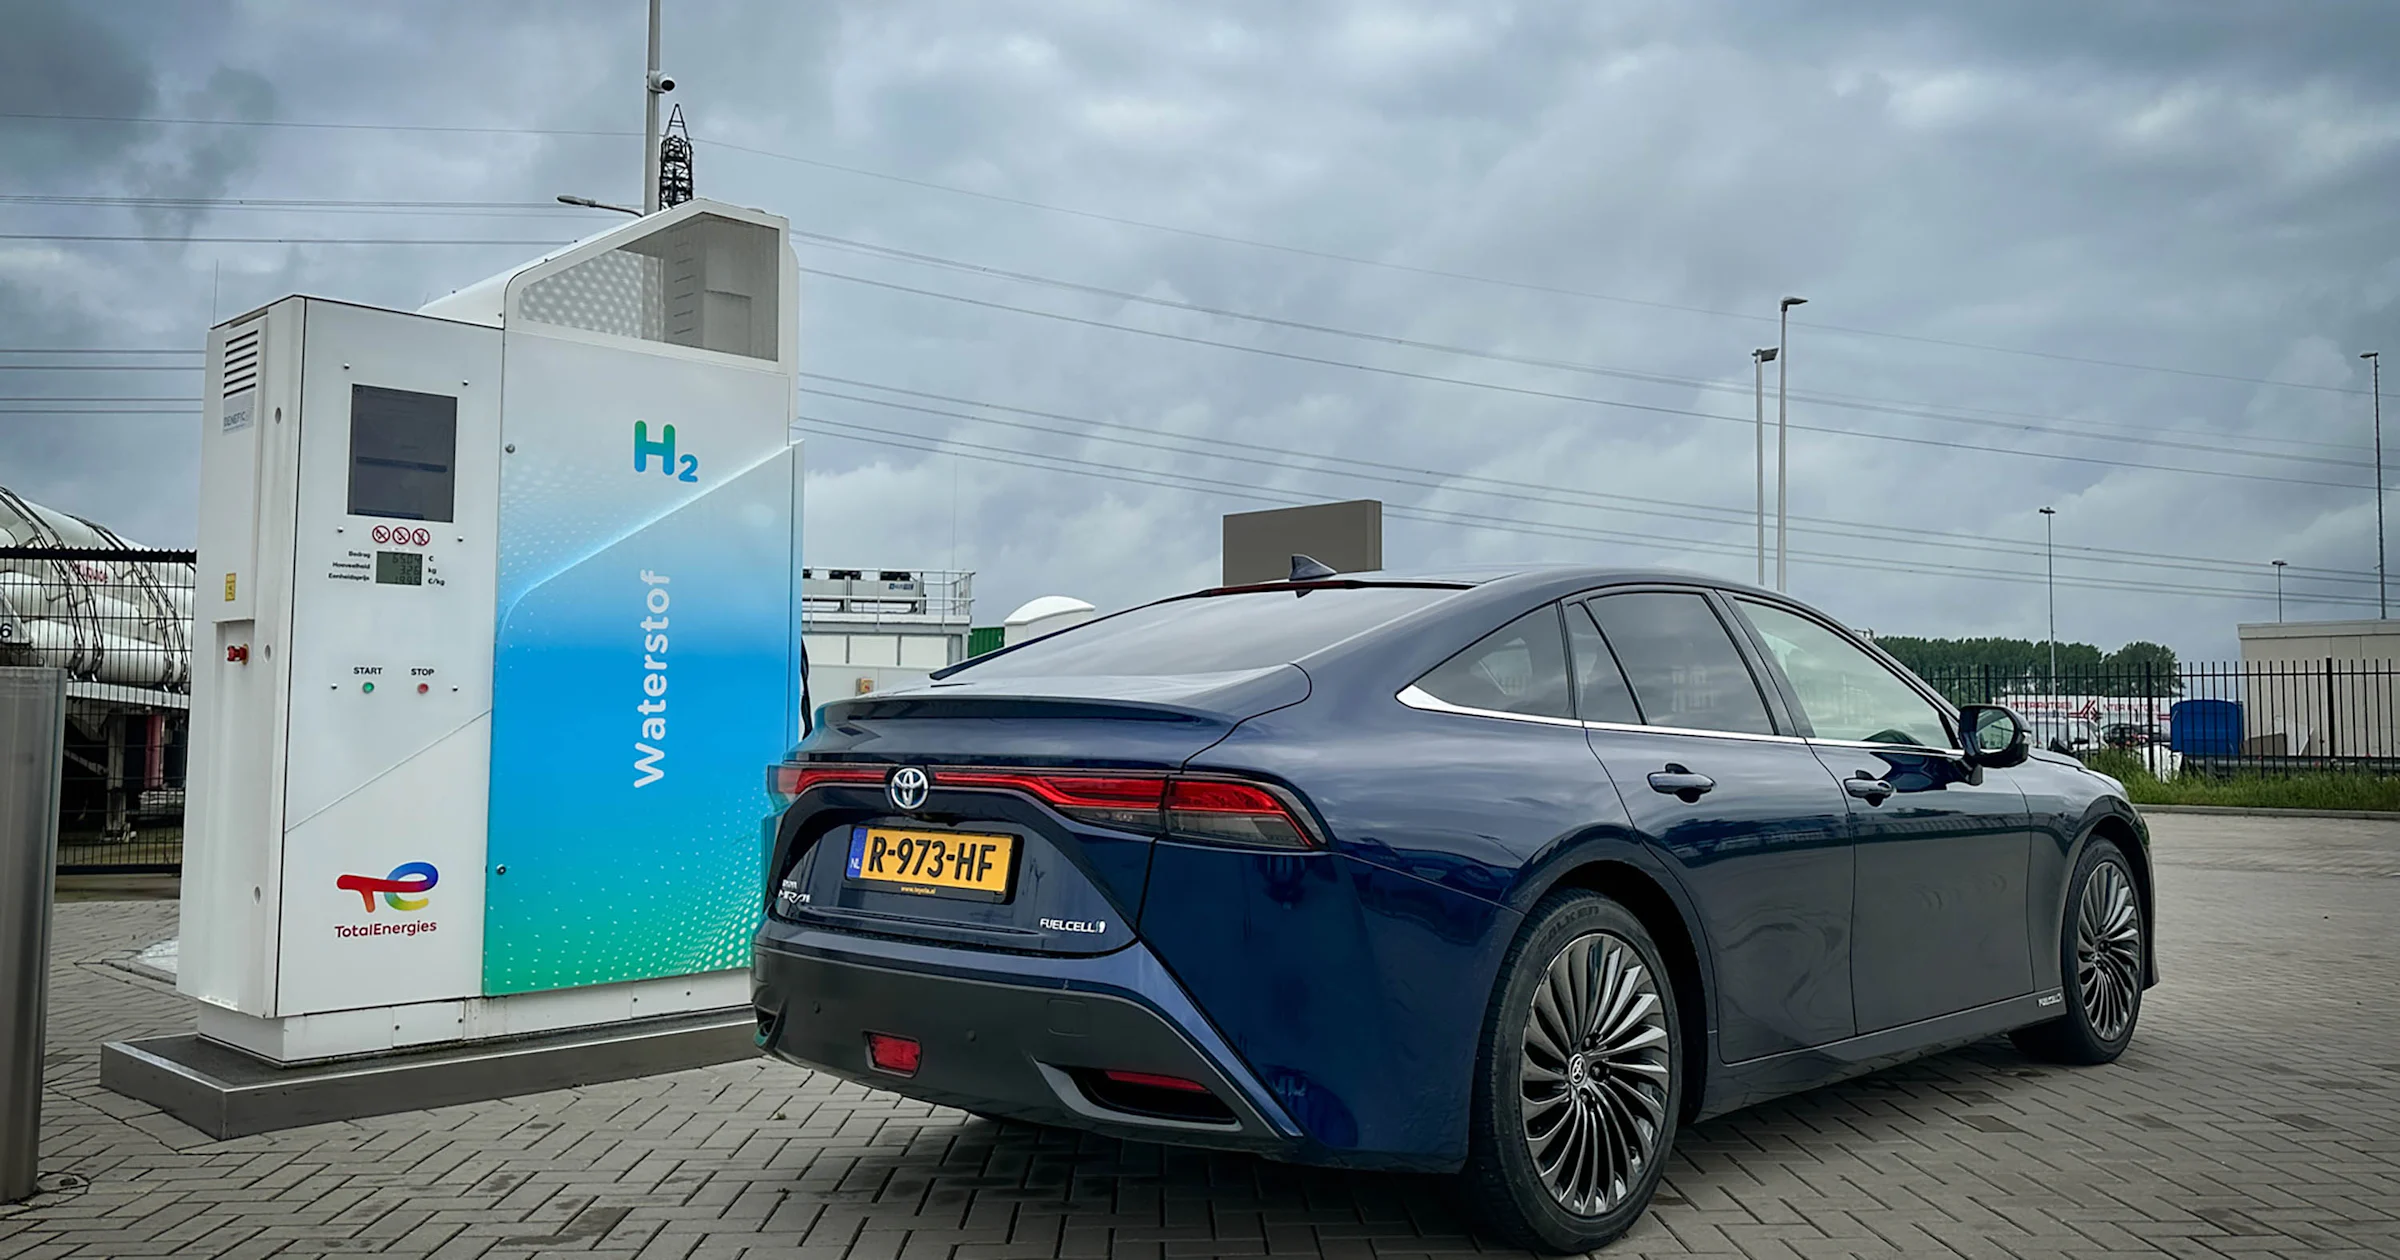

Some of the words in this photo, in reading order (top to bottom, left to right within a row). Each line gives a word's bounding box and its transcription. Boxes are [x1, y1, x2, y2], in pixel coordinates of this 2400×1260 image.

[348, 550, 371, 559] Bedrag
[332, 561, 371, 570] Hoeveelheid
[353, 666, 383, 675] START
[411, 668, 435, 676] STOP
[633, 569, 671, 789] Waterstof
[850, 857, 860, 870] NL
[868, 836, 997, 882] R-973-HF
[334, 920, 437, 938] TotalEnergies
